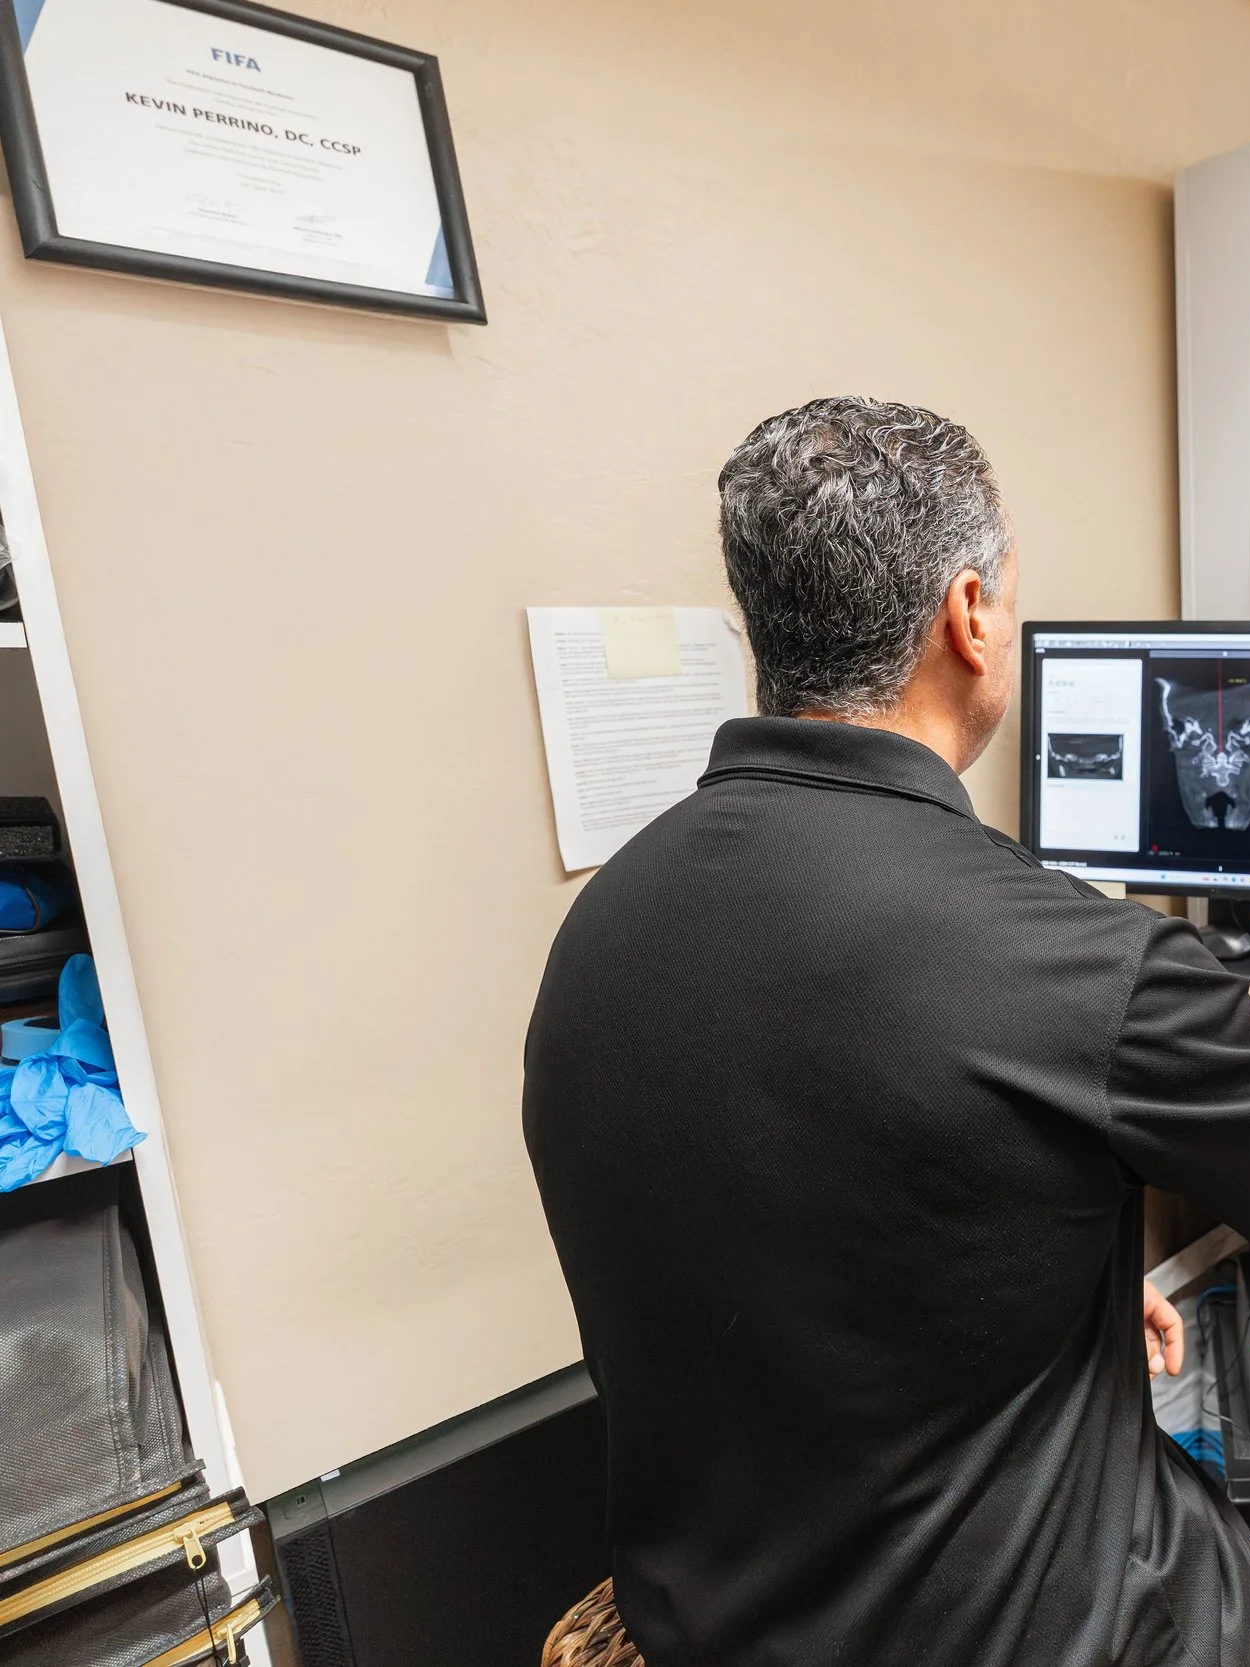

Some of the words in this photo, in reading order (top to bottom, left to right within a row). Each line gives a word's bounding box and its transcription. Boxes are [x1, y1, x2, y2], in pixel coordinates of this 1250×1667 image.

[211, 48, 262, 72] FIFA
[125, 92, 187, 116] KEVIN
[193, 107, 279, 139] PERRINO,
[285, 130, 314, 147] DC,
[320, 138, 362, 156] CCSP
